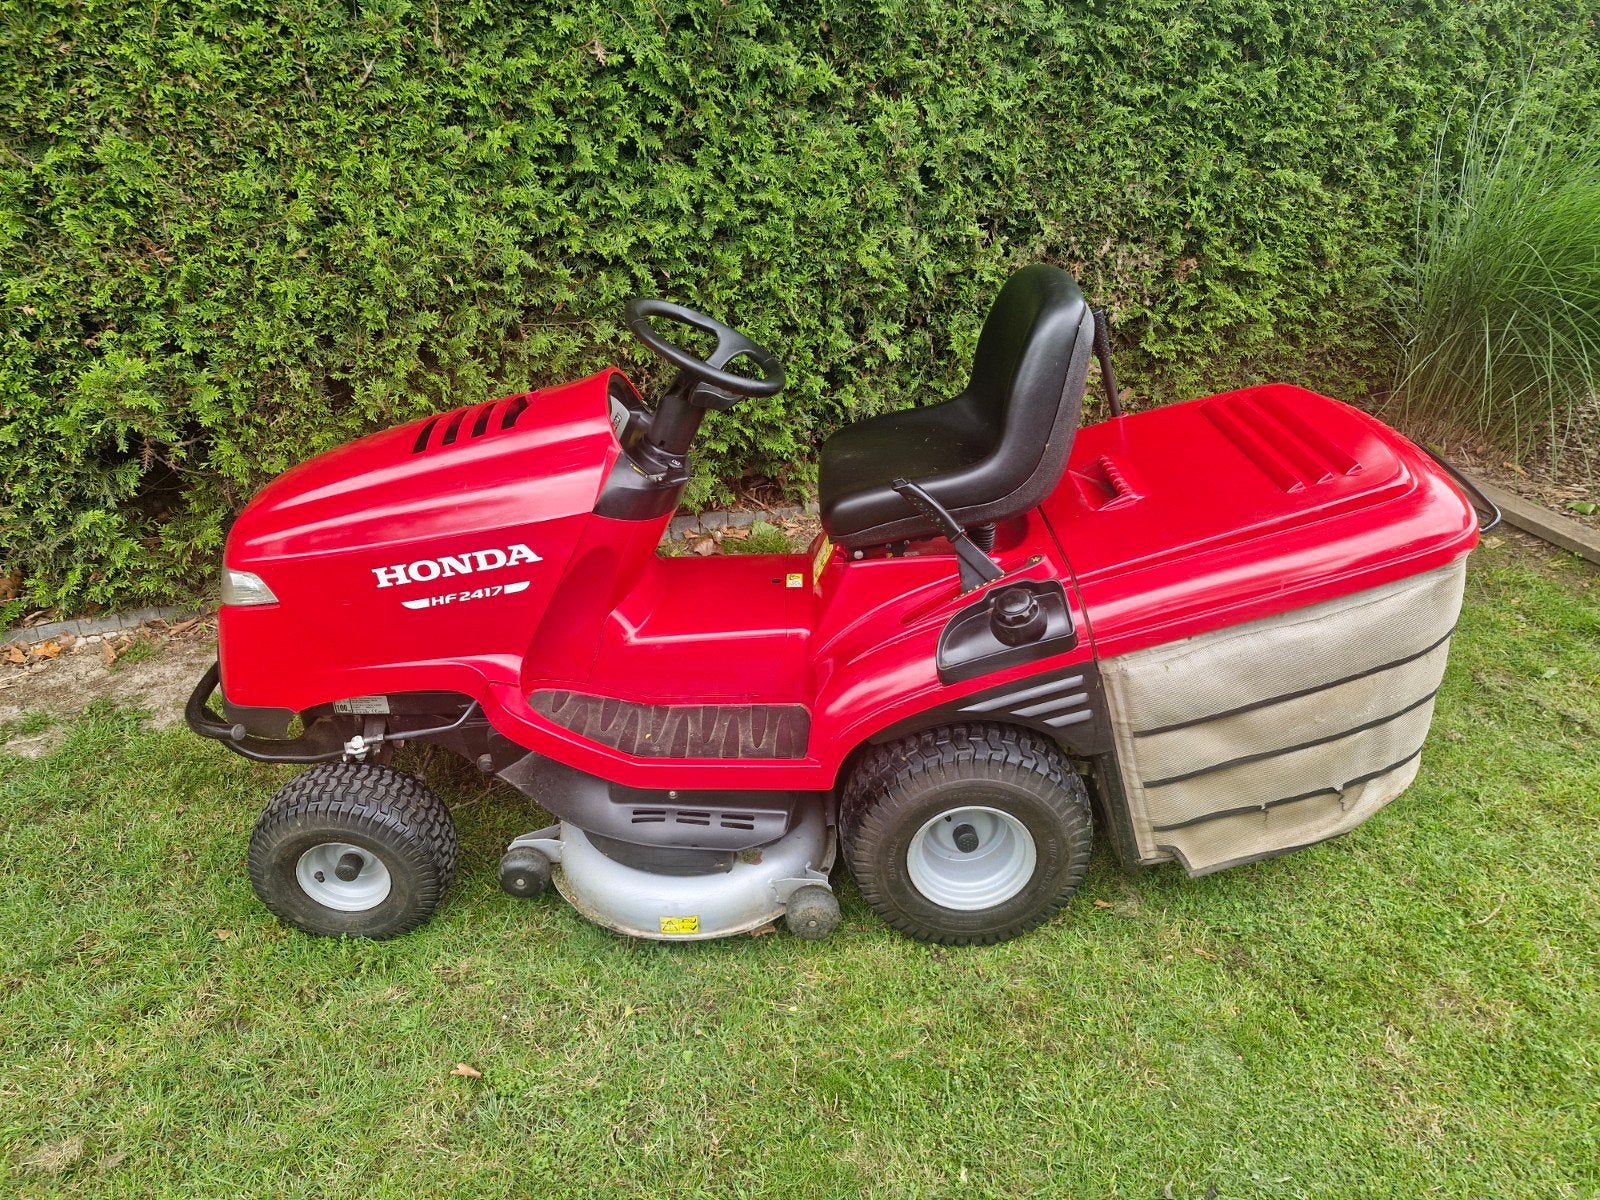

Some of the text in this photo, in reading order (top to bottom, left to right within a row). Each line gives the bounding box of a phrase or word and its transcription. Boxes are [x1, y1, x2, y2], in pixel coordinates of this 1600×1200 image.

[371, 543, 544, 588] HONDA
[431, 586, 503, 606] HF 2417
[336, 704, 348, 712] 100
